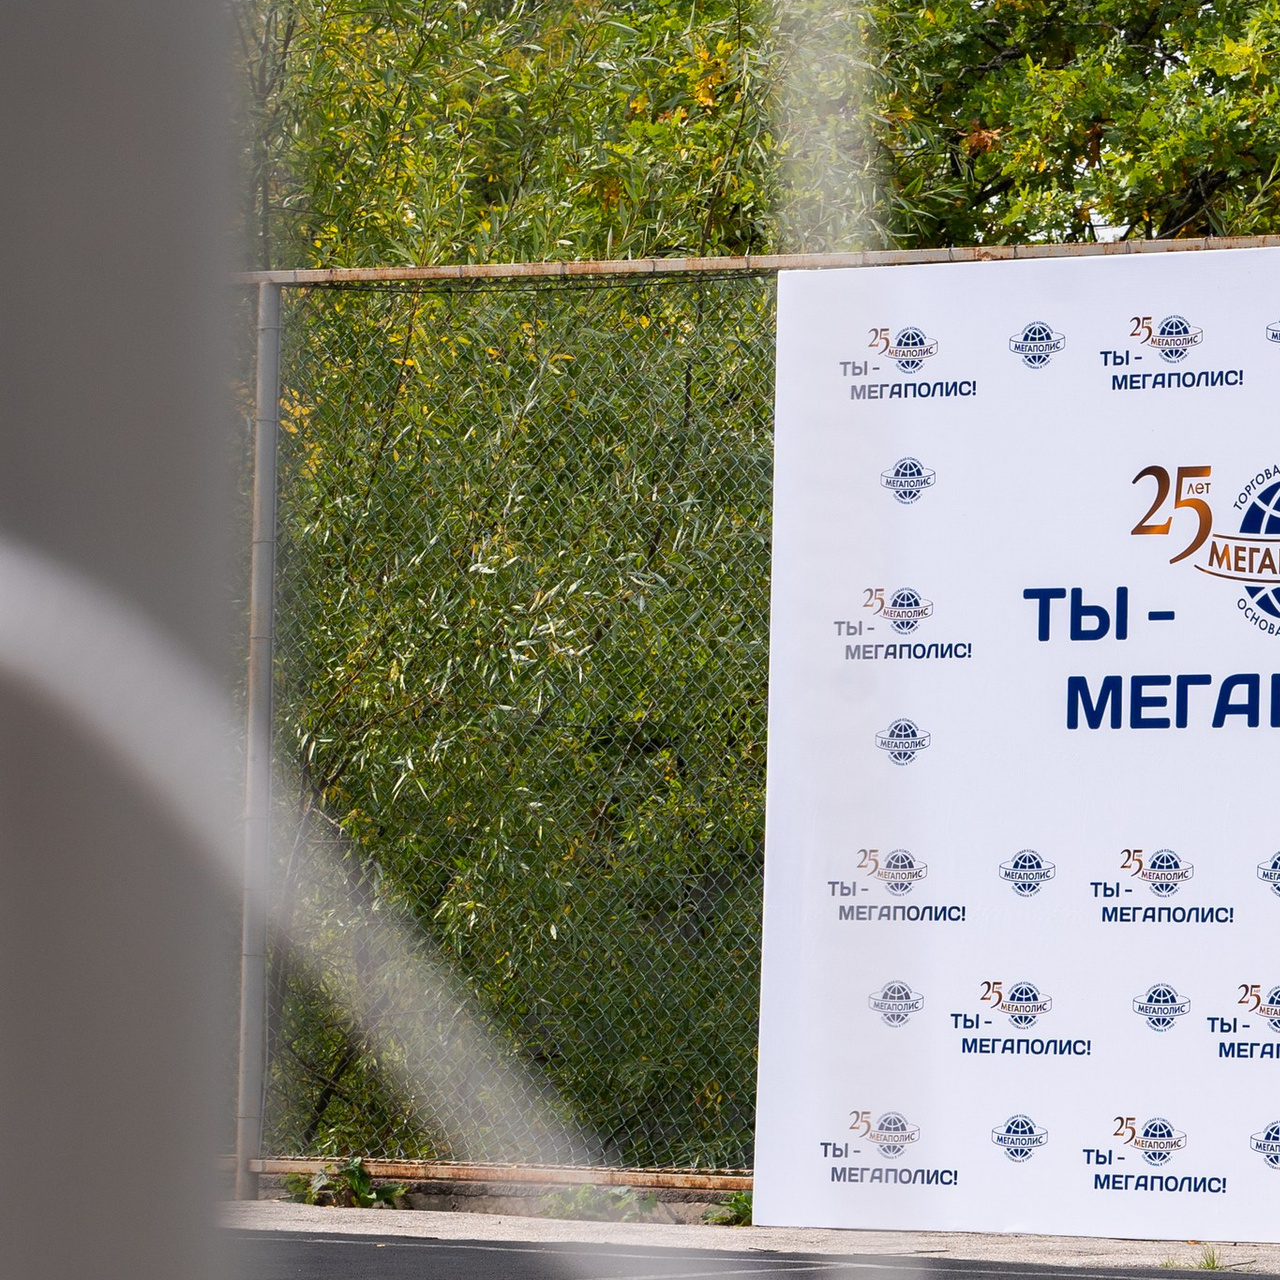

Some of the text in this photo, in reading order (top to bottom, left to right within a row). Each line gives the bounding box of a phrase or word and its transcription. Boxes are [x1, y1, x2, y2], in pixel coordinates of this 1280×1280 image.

[1130, 316, 1152, 344] 25
[868, 328, 889, 354] 25
[1013, 341, 1060, 352] МЕГАПОЛИС
[1151, 335, 1198, 347] МЕГАПОЛИС
[888, 347, 933, 358] МЕГАПОЛИС
[1100, 350, 1130, 366] ТЫ
[840, 361, 868, 376] ТЫ
[1112, 370, 1243, 390] МЕГАПОЛИС!
[851, 381, 976, 400] МЕГАПОЛИС!
[885, 477, 931, 488] МЕГАПОЛИС
[1130, 465, 1213, 564] 25 лет
[863, 588, 884, 615] 25
[883, 608, 928, 619] МЕГАПОЛИС
[1023, 586, 1128, 641] ТЫ
[834, 621, 863, 636] ТЫ
[846, 643, 971, 660] МЕГАПОЛИС!
[880, 739, 926, 749] МЕГАПОЛИС
[857, 849, 879, 876] 25
[1120, 849, 1143, 876] 25
[877, 870, 922, 880] МЕГАПОЛИС
[1003, 870, 1050, 880] МЕГАПОЛИС
[1141, 870, 1188, 881] МЕГАПОЛИС
[828, 882, 857, 896] ТЫ
[1090, 882, 1120, 898] ТЫ
[839, 905, 965, 921] МЕГАПОЛИС!
[1102, 907, 1234, 923] МЕГАПОЛИС!
[980, 981, 1002, 1008] 25
[1238, 984, 1260, 1012] 25
[873, 1001, 919, 1011] МЕГАПОЛИС
[1000, 1002, 1047, 1013] МЕГАПОЛИС
[1137, 1005, 1185, 1015] МЕГАПОЛИС
[950, 1014, 980, 1029] ТЫ
[1207, 1017, 1237, 1033] ТЫ
[962, 1038, 1091, 1055] МЕГАПОЛИС!
[849, 1111, 871, 1137] 25
[1113, 1117, 1135, 1144] 25
[869, 1132, 915, 1143] МЕГАПОЛИС
[996, 1136, 1043, 1146] МЕГАПОЛИС
[1134, 1138, 1181, 1150] МЕГАПОЛИС
[820, 1143, 849, 1158] ТЫ
[1083, 1149, 1113, 1165] ТЫ
[831, 1167, 958, 1185] МЕГАПОЛИС!
[1094, 1174, 1226, 1193] МЕГАПОЛИС!
